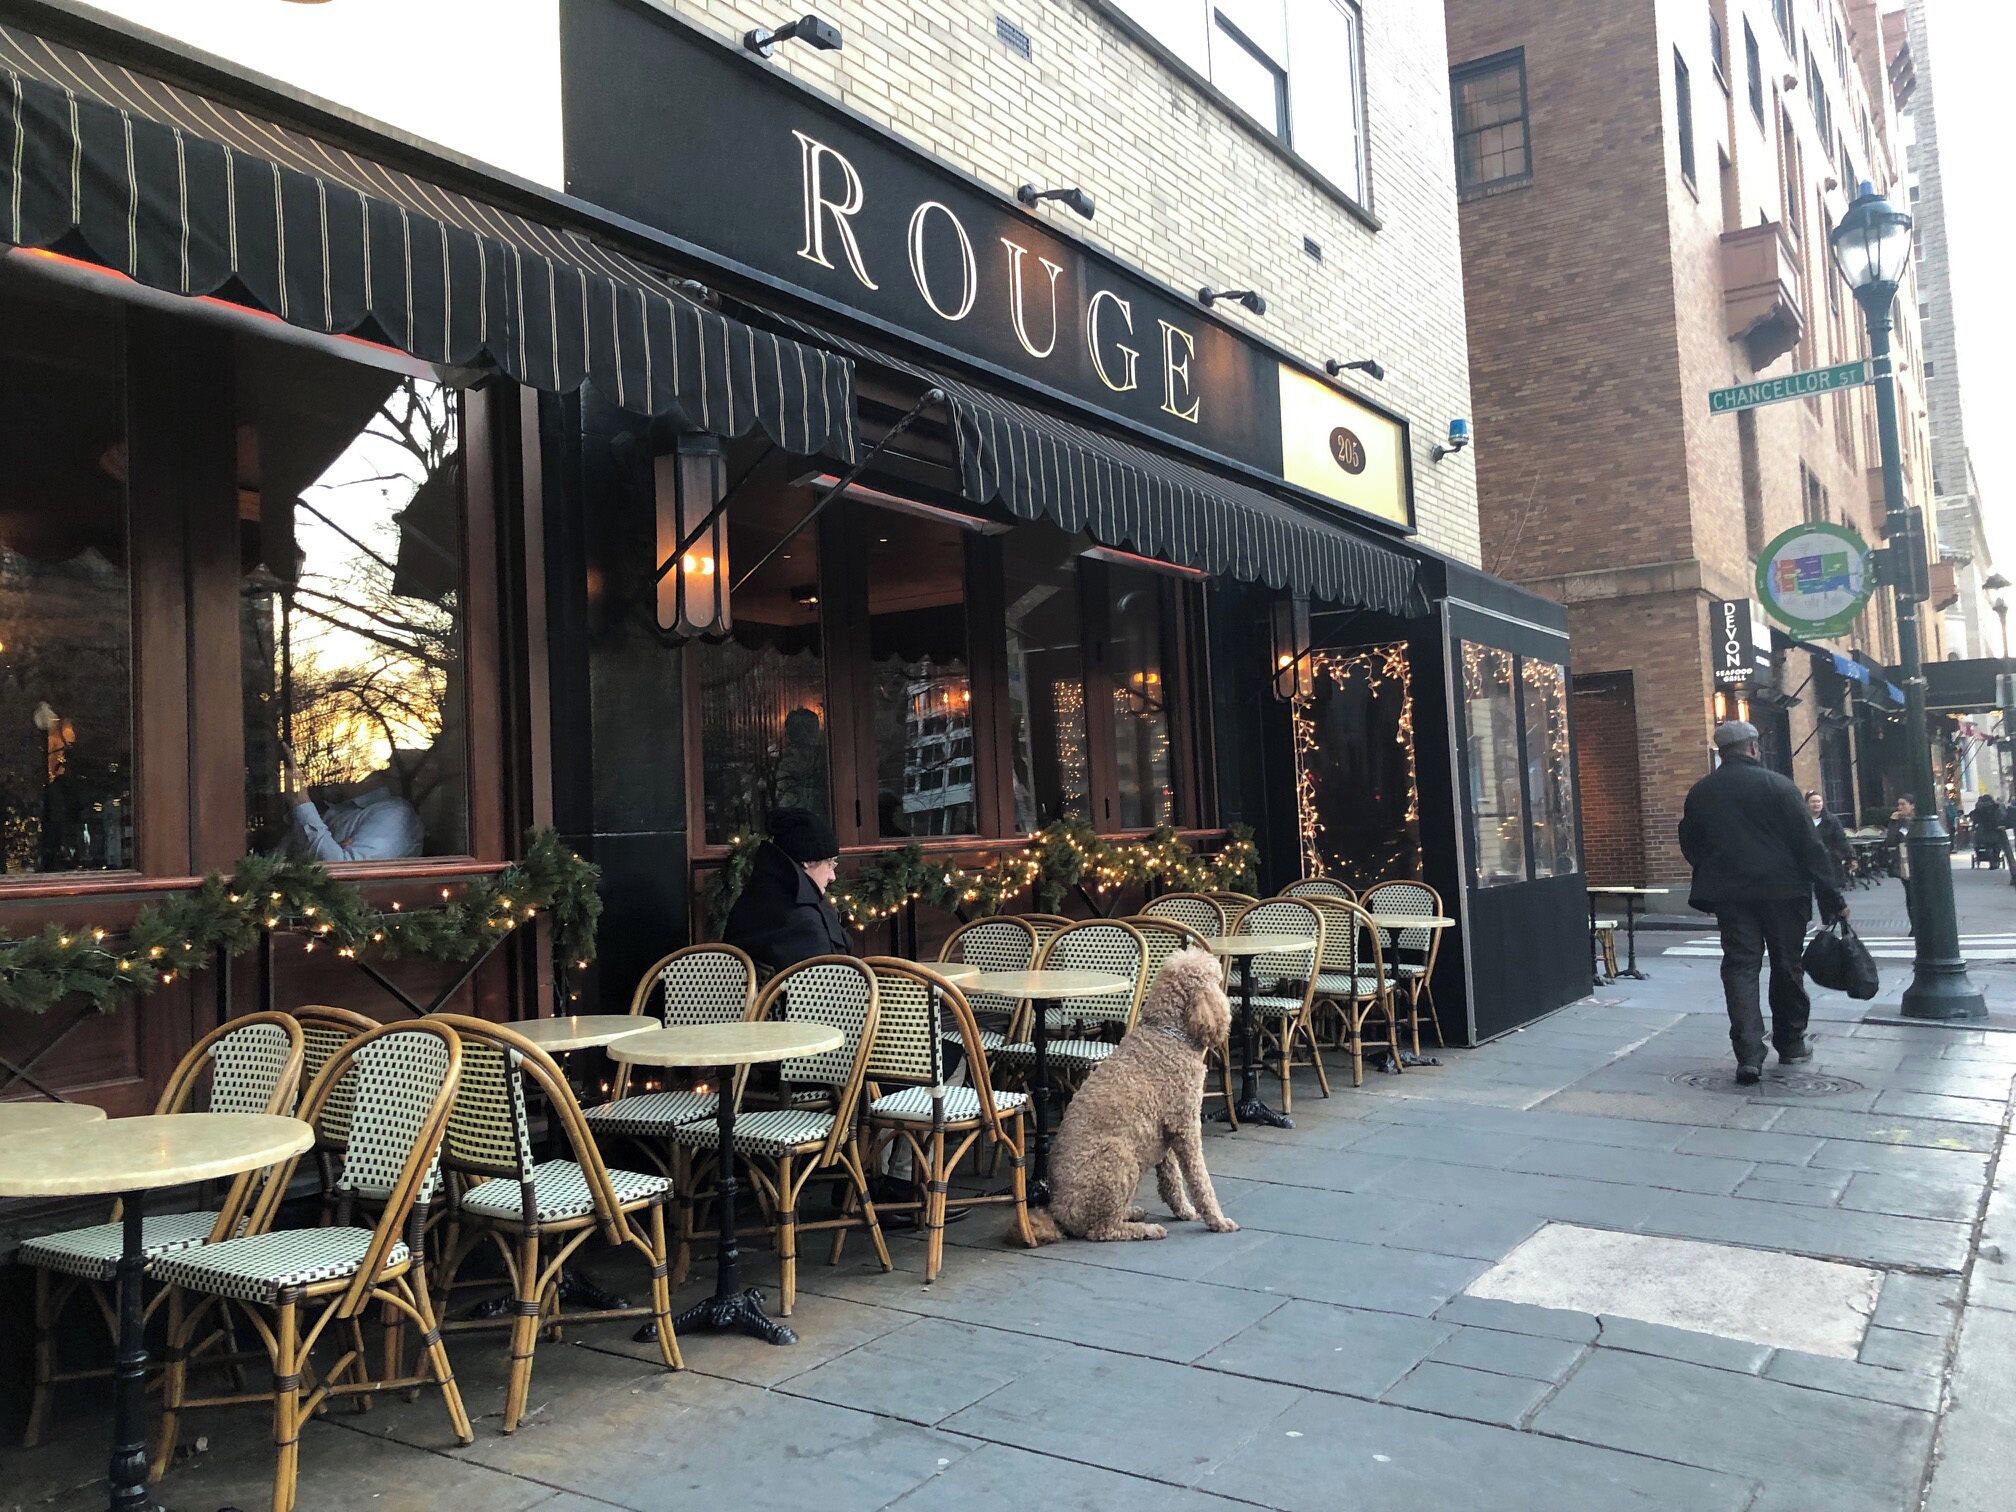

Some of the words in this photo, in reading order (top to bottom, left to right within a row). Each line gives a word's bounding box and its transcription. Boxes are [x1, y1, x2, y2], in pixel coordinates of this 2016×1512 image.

[792, 130, 1200, 424] ROUGE
[1713, 373, 1831, 410] CHANCELLOR
[1839, 370, 1857, 385] ST
[1337, 434, 1359, 467] 205
[1724, 602, 1740, 667] DEVON
[1715, 668, 1753, 677] SEAFOOD
